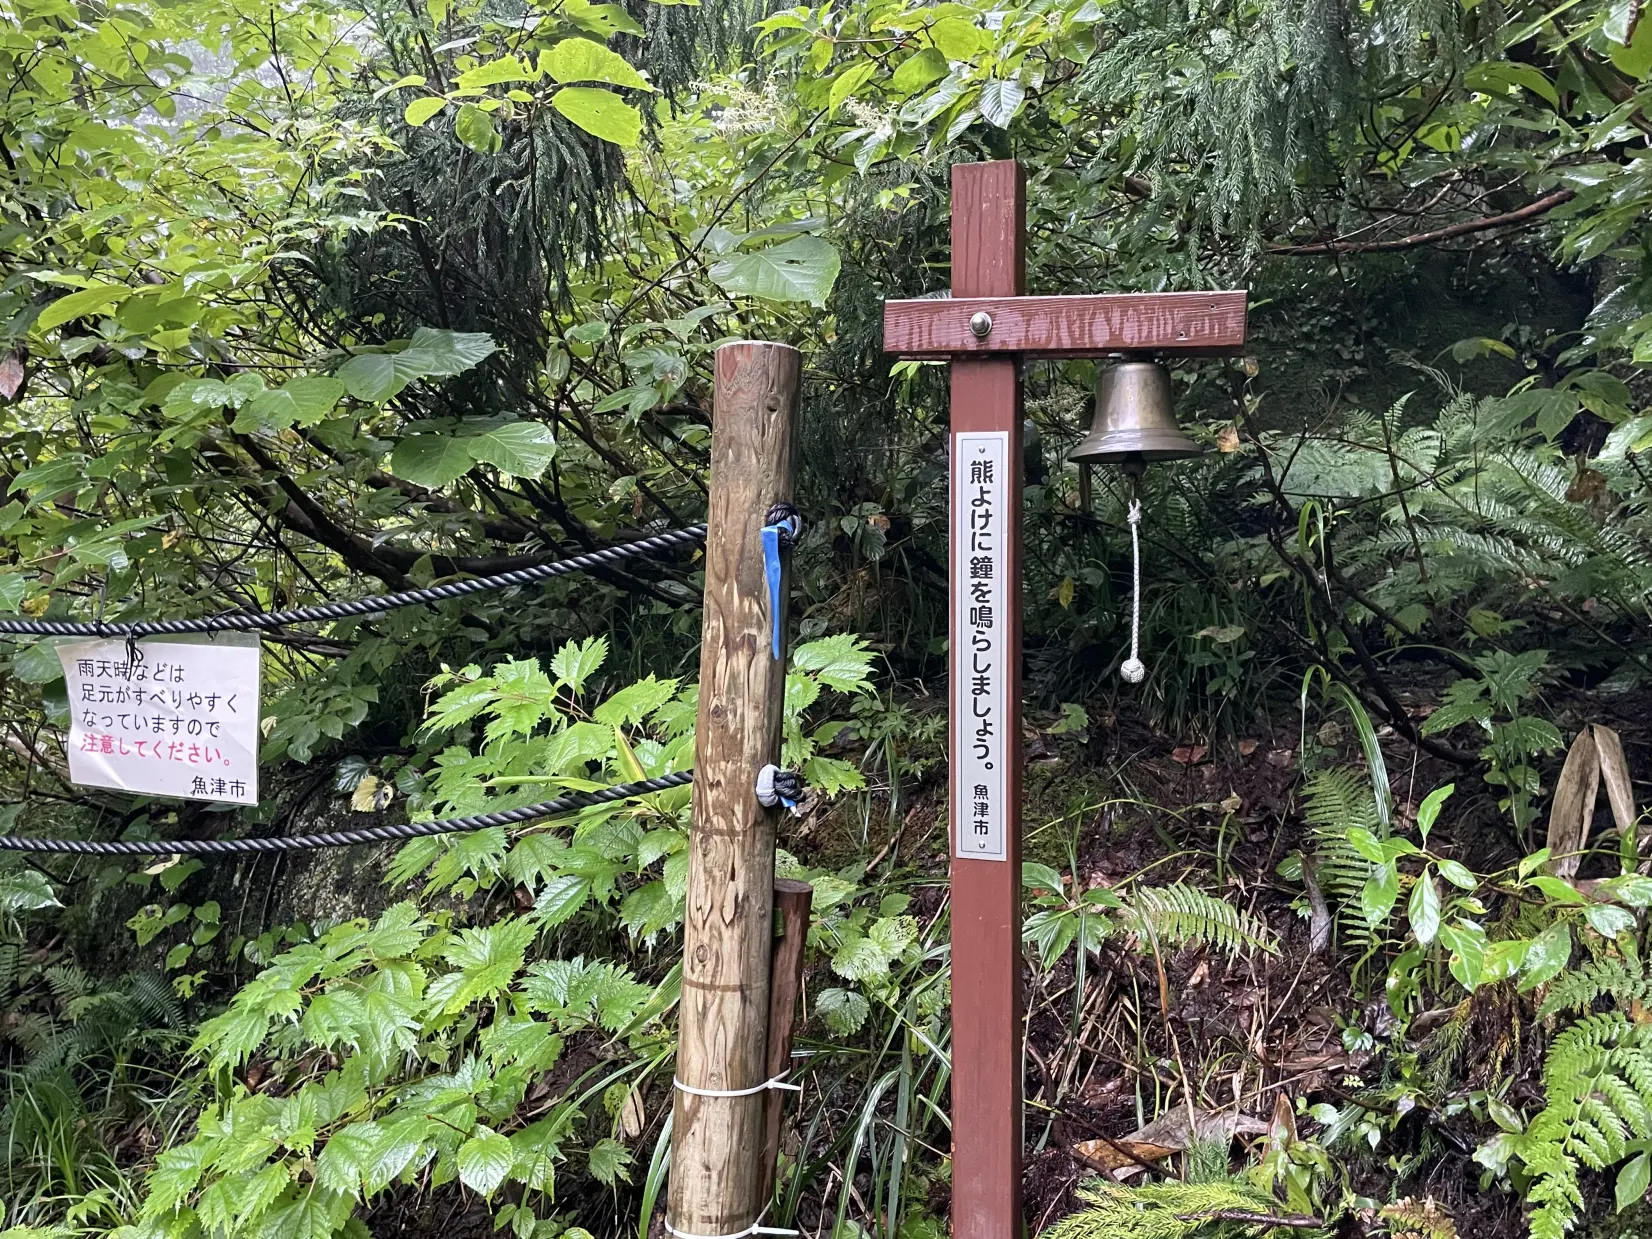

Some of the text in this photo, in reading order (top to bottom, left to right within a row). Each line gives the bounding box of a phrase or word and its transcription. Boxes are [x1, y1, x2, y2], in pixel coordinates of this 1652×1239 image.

[969, 460, 994, 770] 熊よけに鐘を鳴らしましょう。
[81, 683, 237, 714] 足元がすべりやすく
[82, 708, 221, 738] なっていますので
[80, 733, 230, 766] 注意してください。
[190, 775, 246, 798] 魚津市
[973, 784, 989, 836] 魚津市
